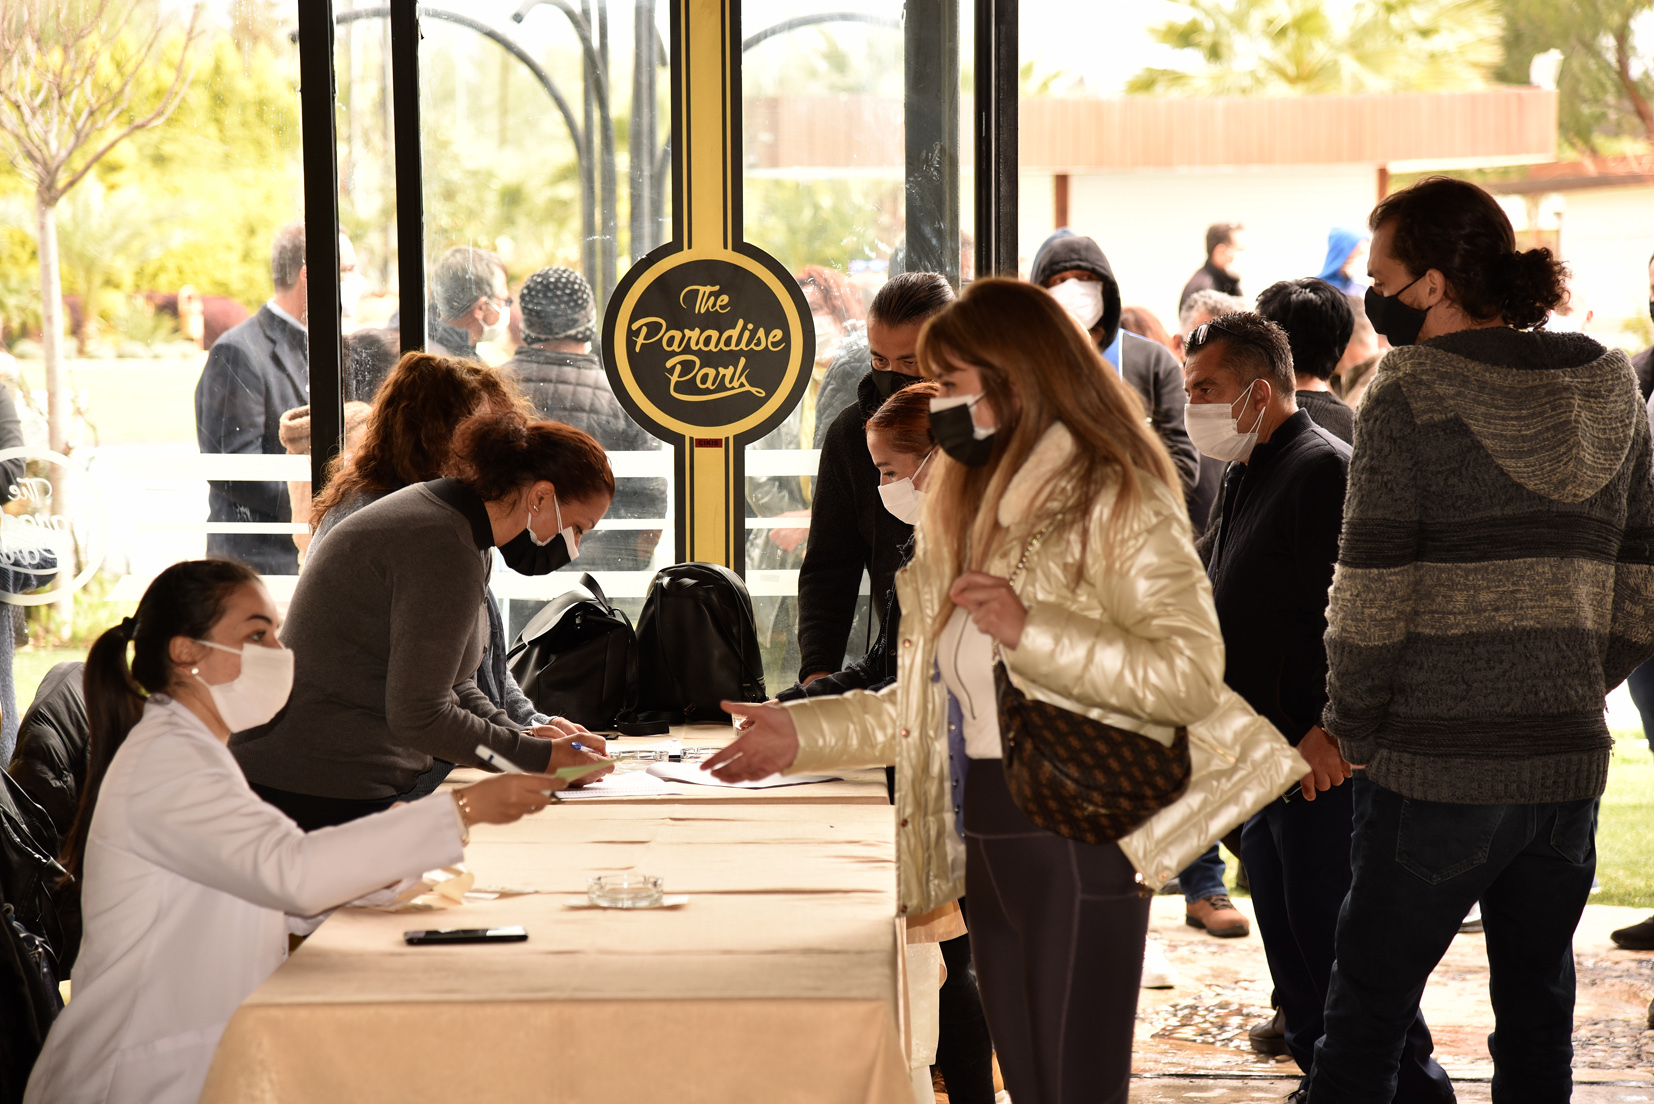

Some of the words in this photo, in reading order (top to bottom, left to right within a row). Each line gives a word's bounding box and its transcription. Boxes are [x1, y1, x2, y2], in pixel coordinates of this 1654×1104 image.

[680, 285, 731, 314] The
[631, 316, 785, 353] Paradise
[664, 355, 767, 402] Park
